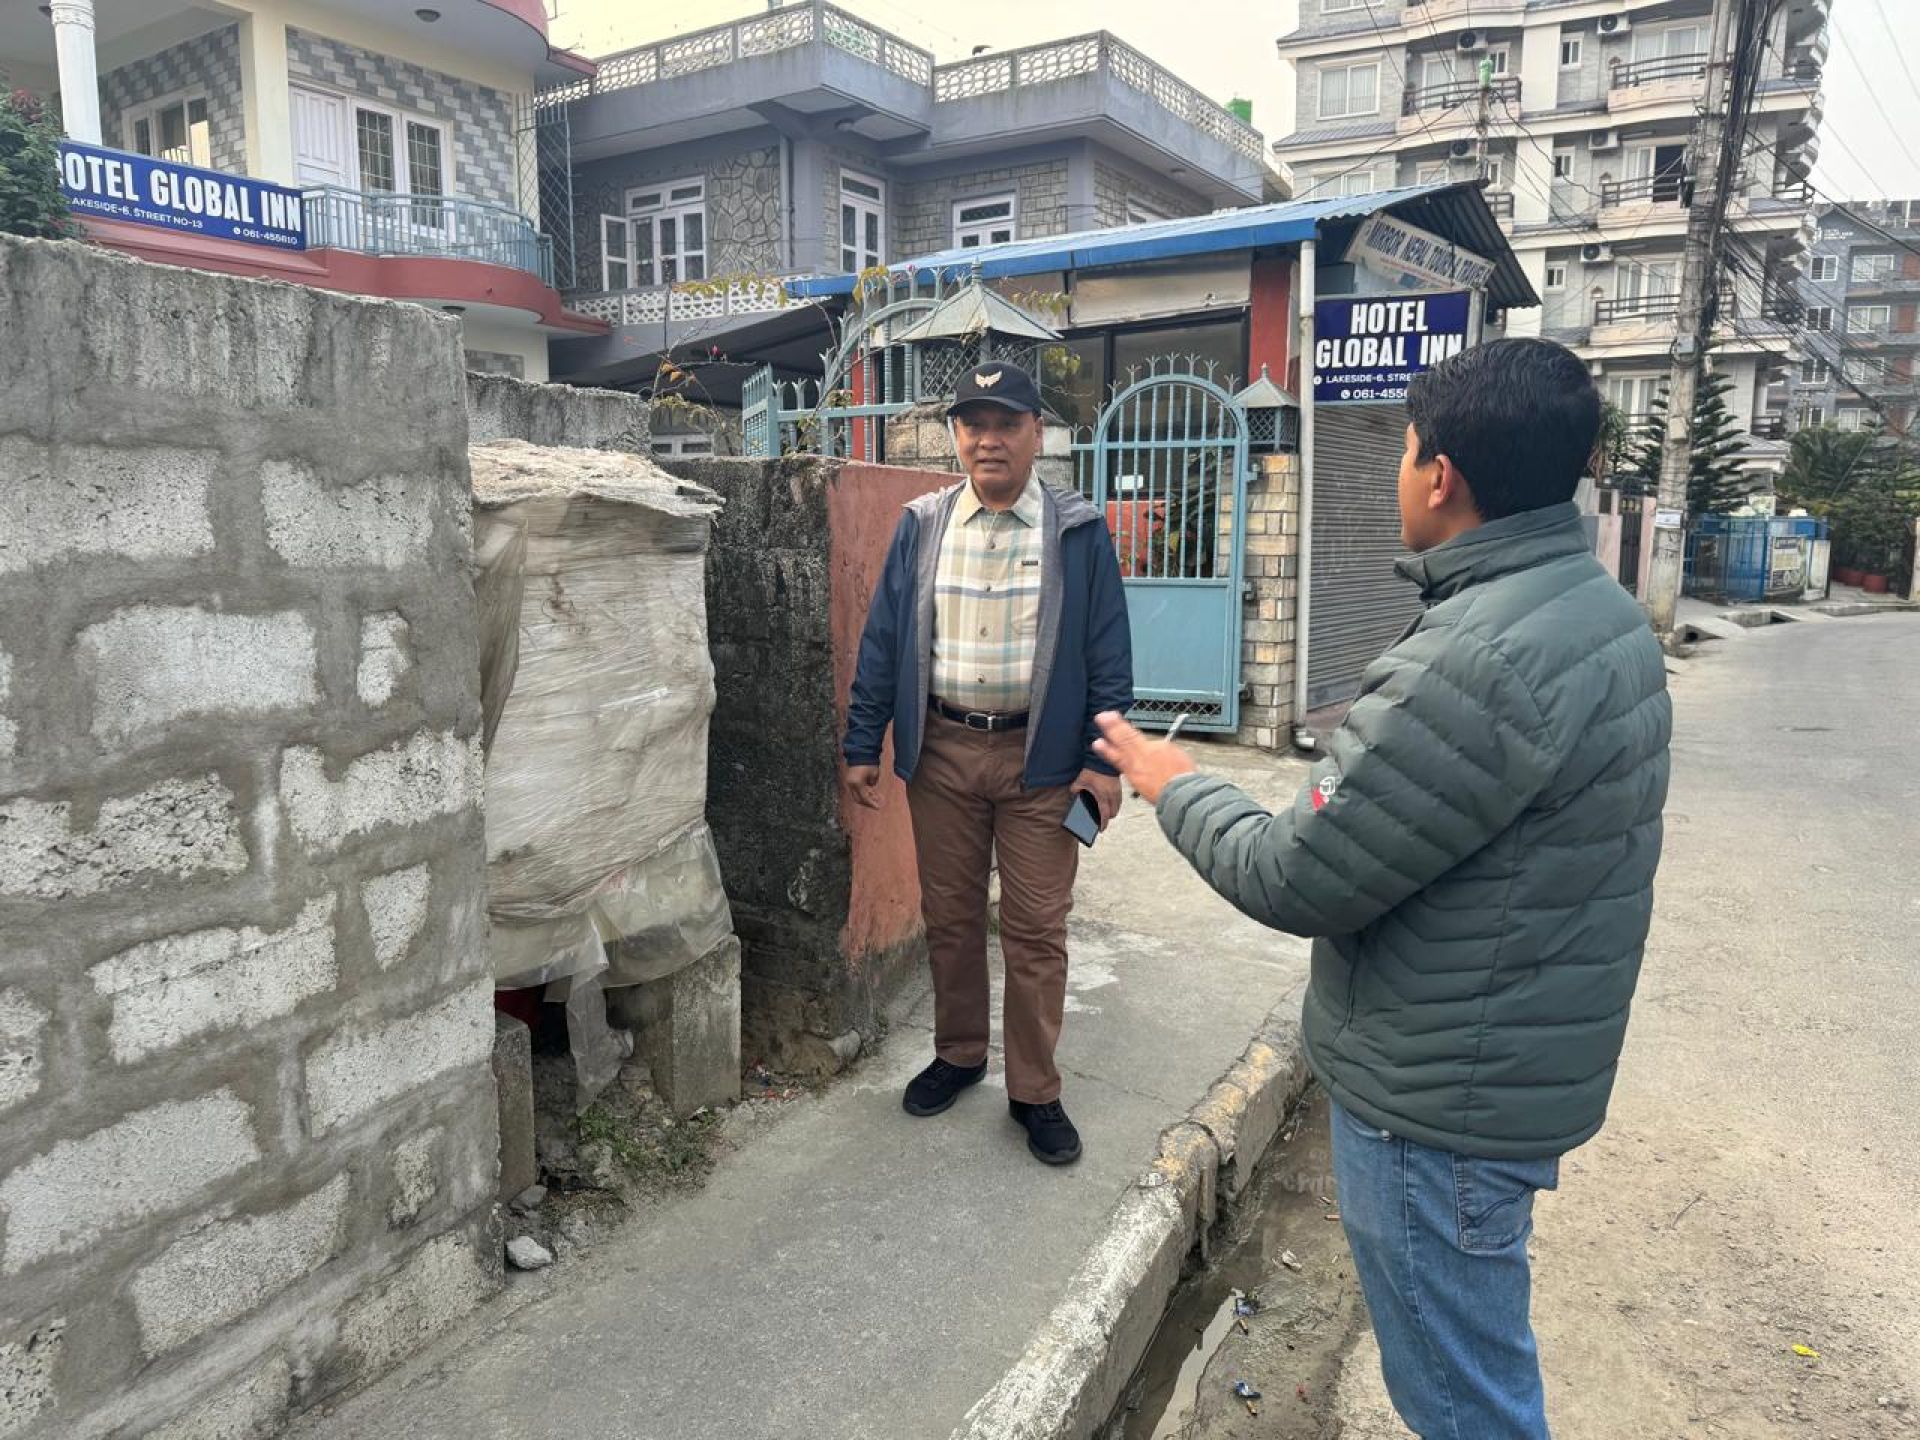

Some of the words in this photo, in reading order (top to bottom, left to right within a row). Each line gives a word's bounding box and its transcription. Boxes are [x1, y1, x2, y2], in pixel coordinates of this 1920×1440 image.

[67, 197, 133, 217] AKESIDE-6,
[134, 207, 171, 223] STREET
[173, 216, 203, 229] NO-13
[150, 169, 254, 223] GLOBAL
[260, 190, 301, 232] INN
[1350, 300, 1428, 335] HOTEL
[1316, 336, 1408, 369] GLOBAL
[1419, 334, 1462, 366] INN
[1352, 388, 1408, 399] 061-455
[1387, 372, 1416, 383] STRE
